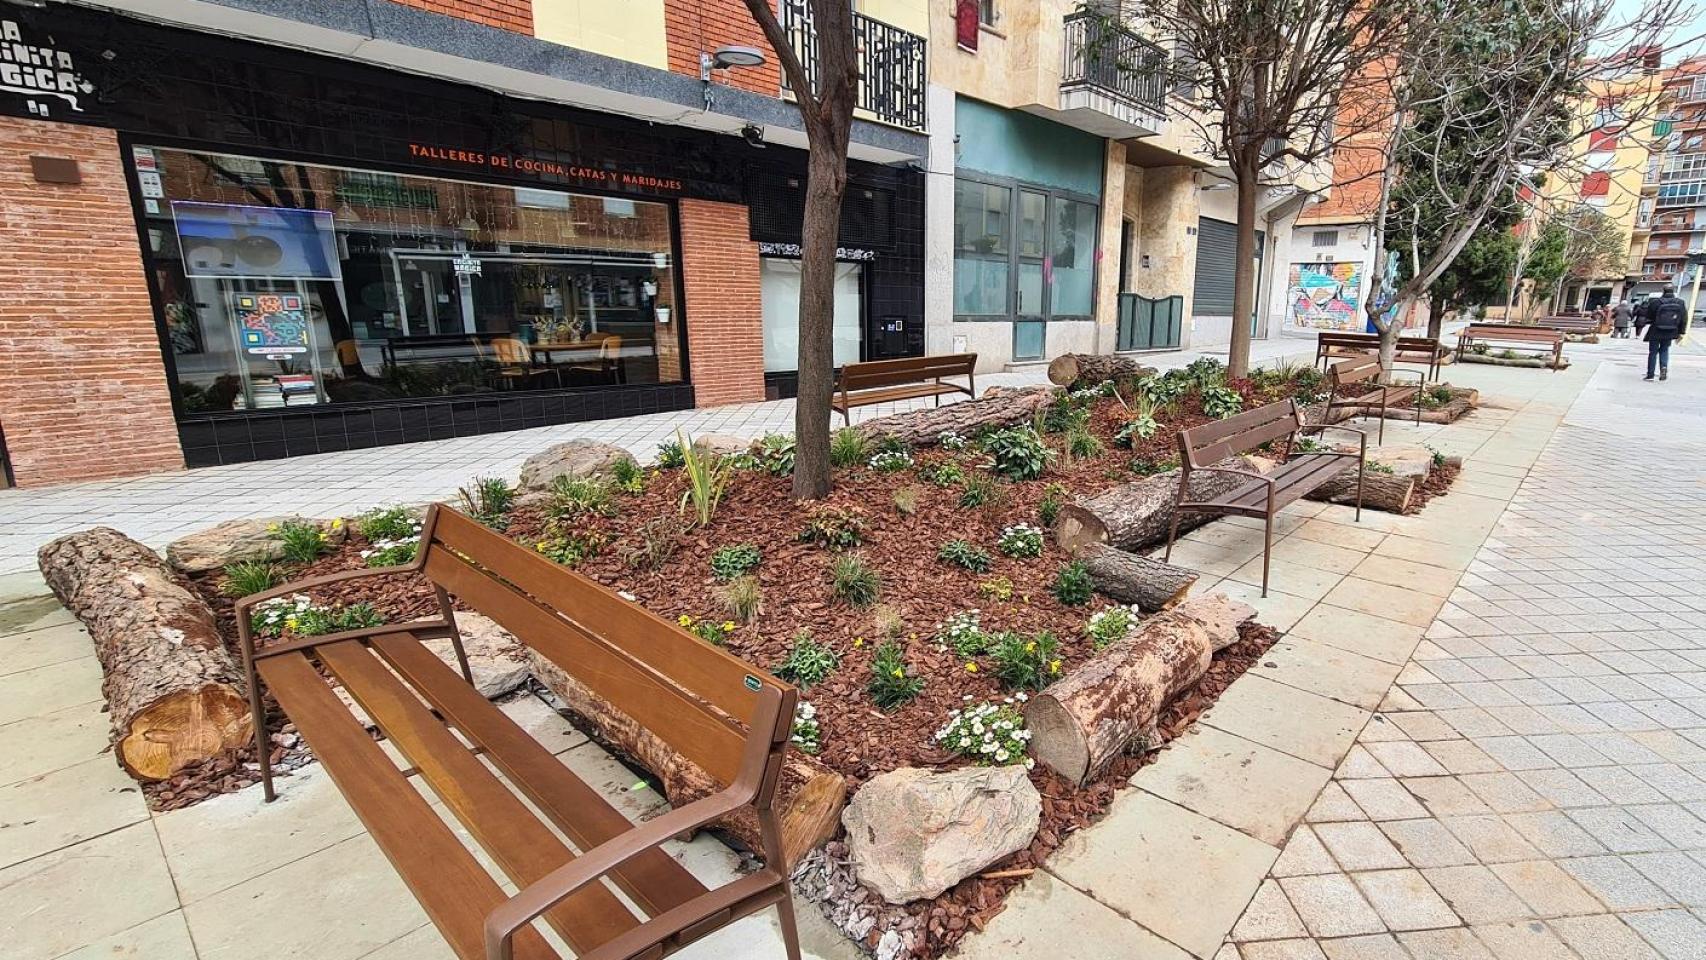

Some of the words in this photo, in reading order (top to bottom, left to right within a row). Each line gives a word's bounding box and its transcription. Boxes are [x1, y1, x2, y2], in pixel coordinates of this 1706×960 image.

[0, 20, 21, 42] A
[409, 144, 484, 164] TALLERES
[491, 156, 508, 167] DE
[610, 172, 617, 181] Y
[623, 174, 682, 190] MARIDAJES
